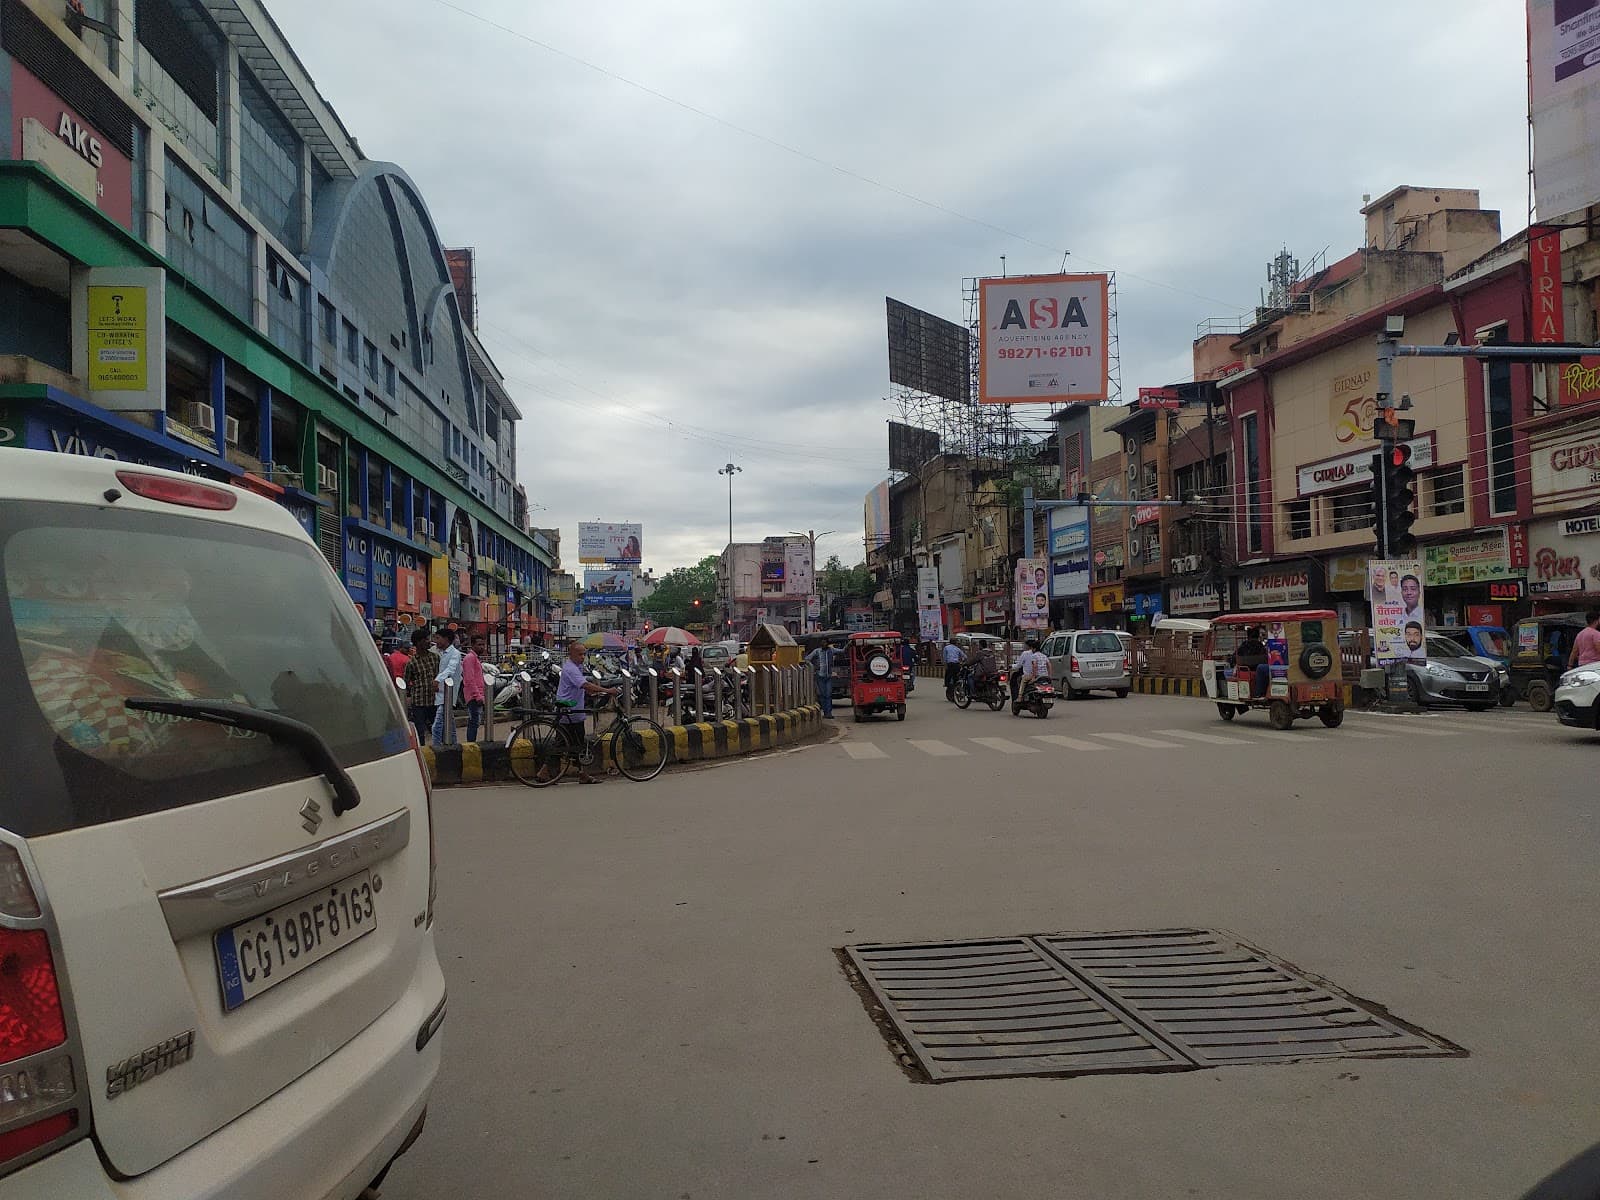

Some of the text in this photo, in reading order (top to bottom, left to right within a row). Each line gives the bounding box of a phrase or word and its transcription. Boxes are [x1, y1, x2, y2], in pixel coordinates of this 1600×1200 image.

[59, 112, 103, 168] AKS
[1000, 296, 1088, 330] ASA
[998, 333, 1088, 342] ADVERTISING AGENCY
[1137, 508, 1152, 522] OYO
[1513, 526, 1523, 564] THALI
[1254, 573, 1308, 590] FRIENDS
[1490, 583, 1518, 596] BAR
[240, 881, 373, 983] CG19BF8163
